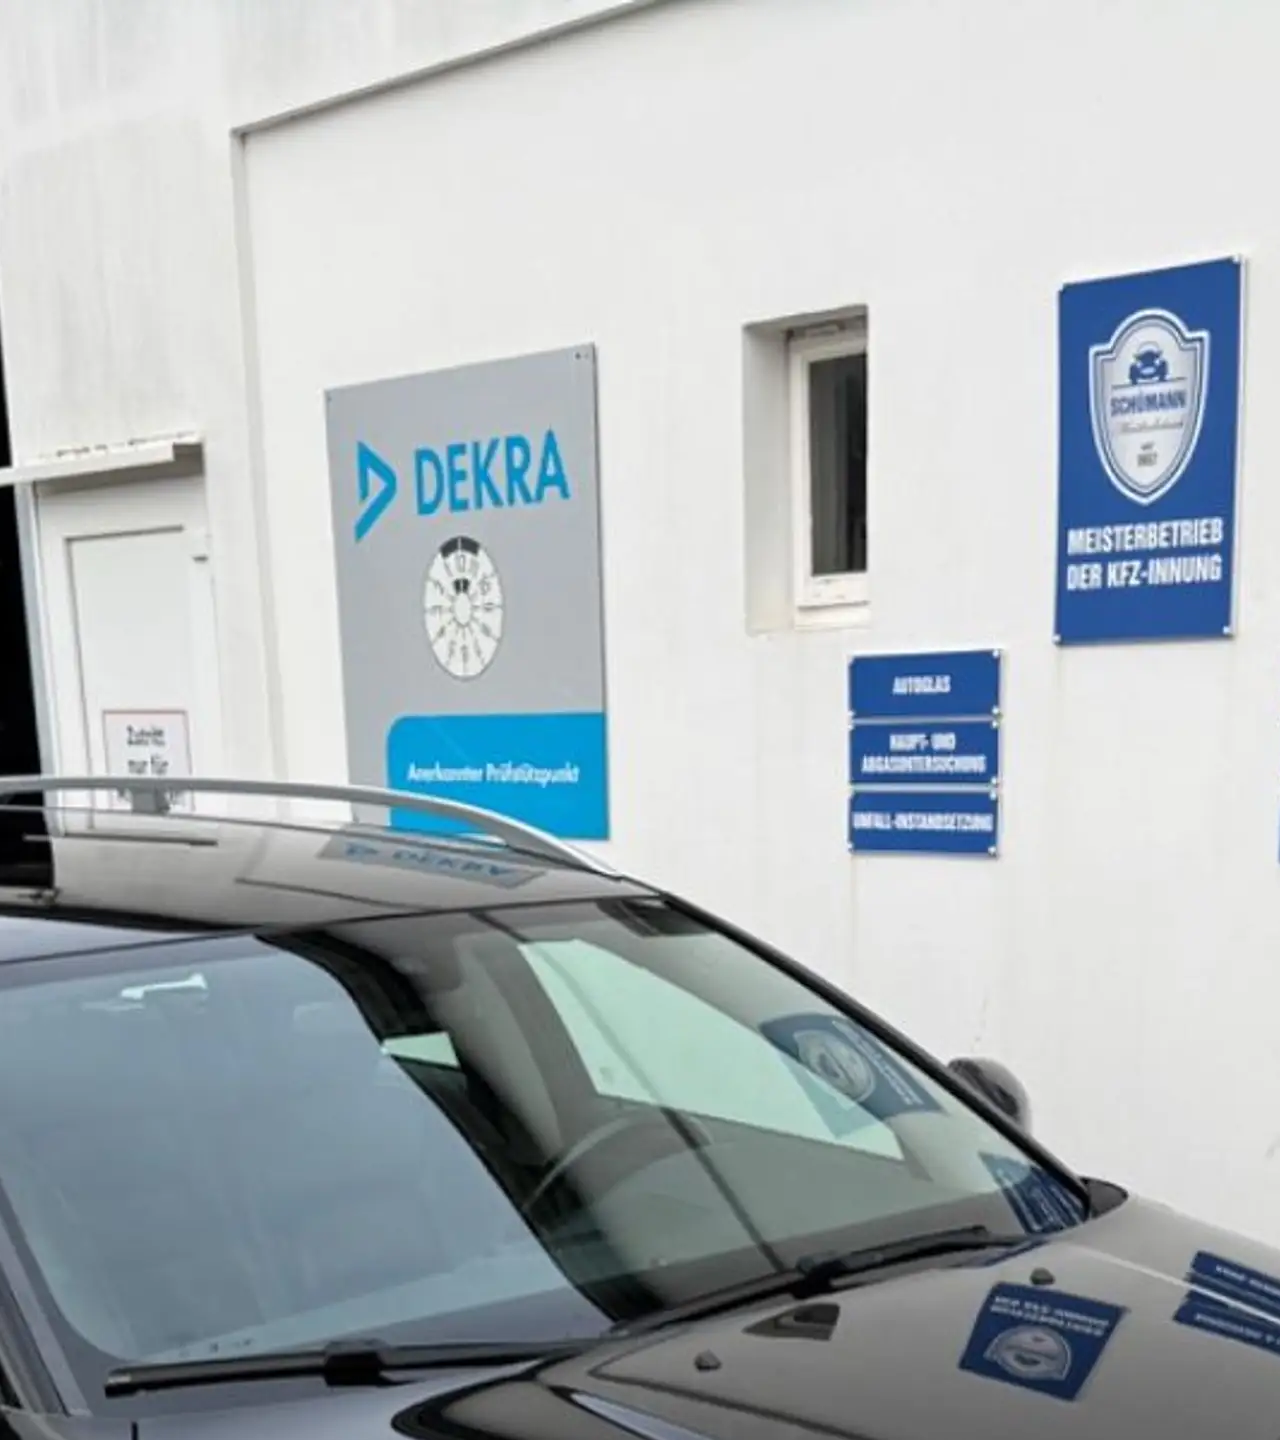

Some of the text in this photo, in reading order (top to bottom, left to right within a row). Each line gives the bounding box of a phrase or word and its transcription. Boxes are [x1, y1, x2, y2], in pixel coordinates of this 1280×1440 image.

[414, 428, 571, 516] DEKRA
[1067, 516, 1224, 556] MEISTERBETRIEB
[1066, 553, 1223, 592] DER KFZ-INNUNG
